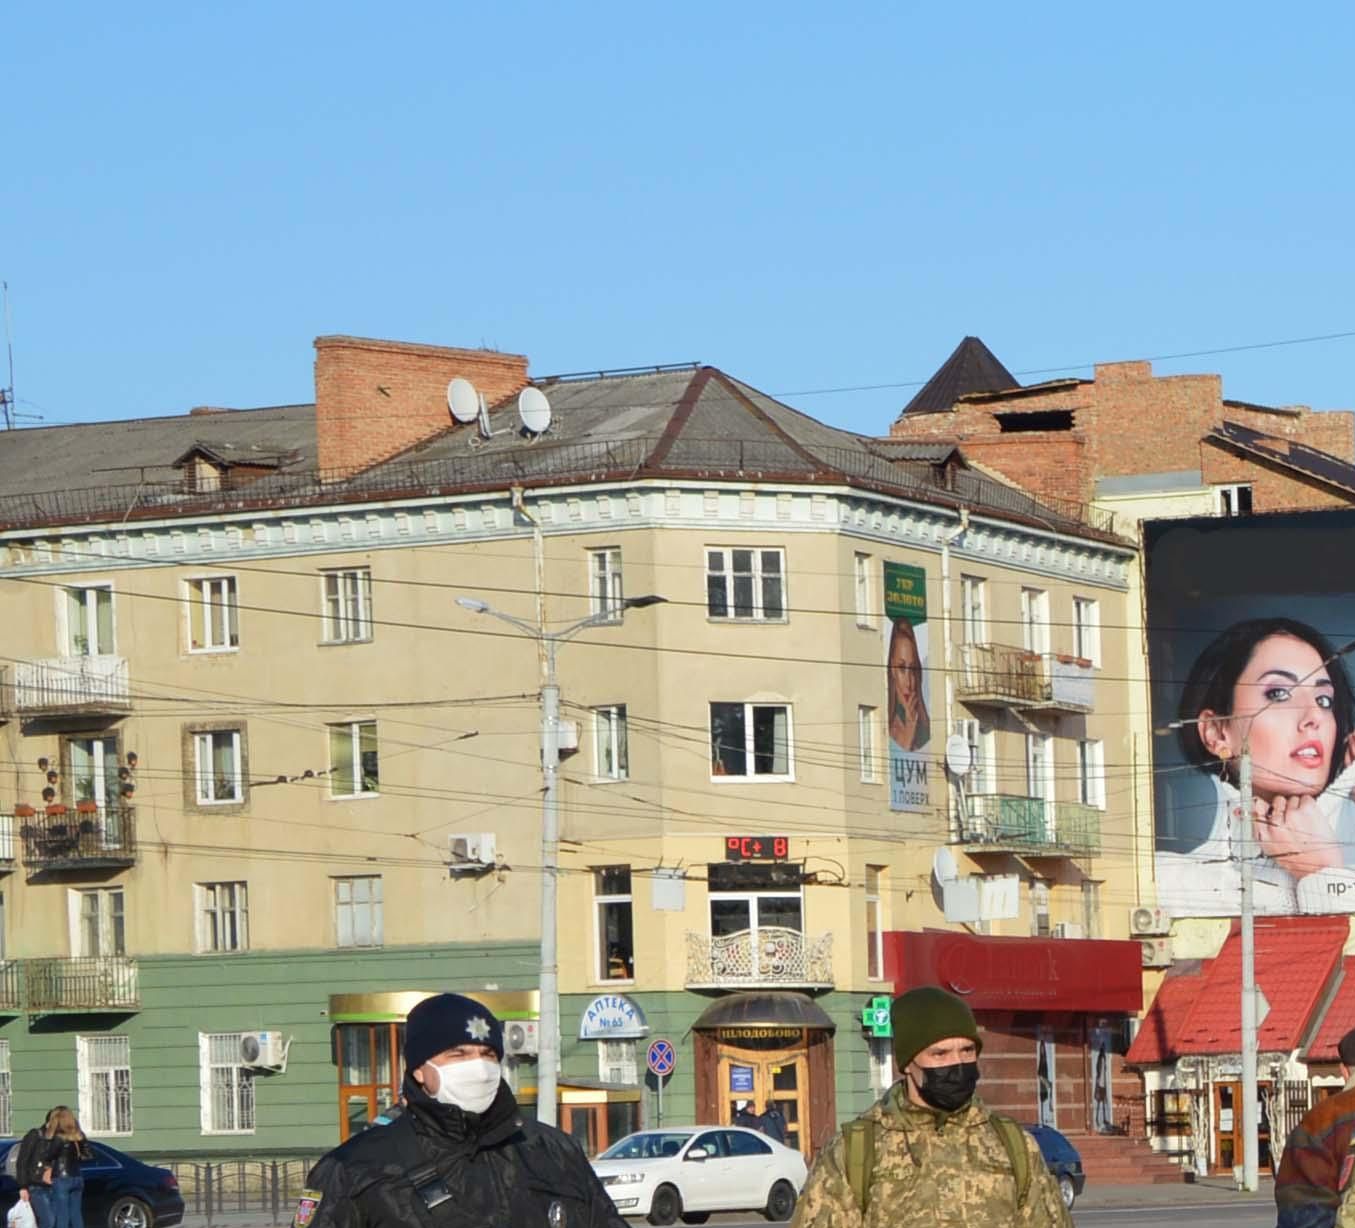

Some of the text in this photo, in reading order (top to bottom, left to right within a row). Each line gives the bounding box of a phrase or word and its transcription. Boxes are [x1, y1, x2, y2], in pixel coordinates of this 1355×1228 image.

[894, 758, 928, 788] ЦУМ
[773, 838, 787, 857] 8
[587, 997, 635, 1022] АПТЕКА
[722, 1028, 802, 1040] ЦІЛОДОБОВО
